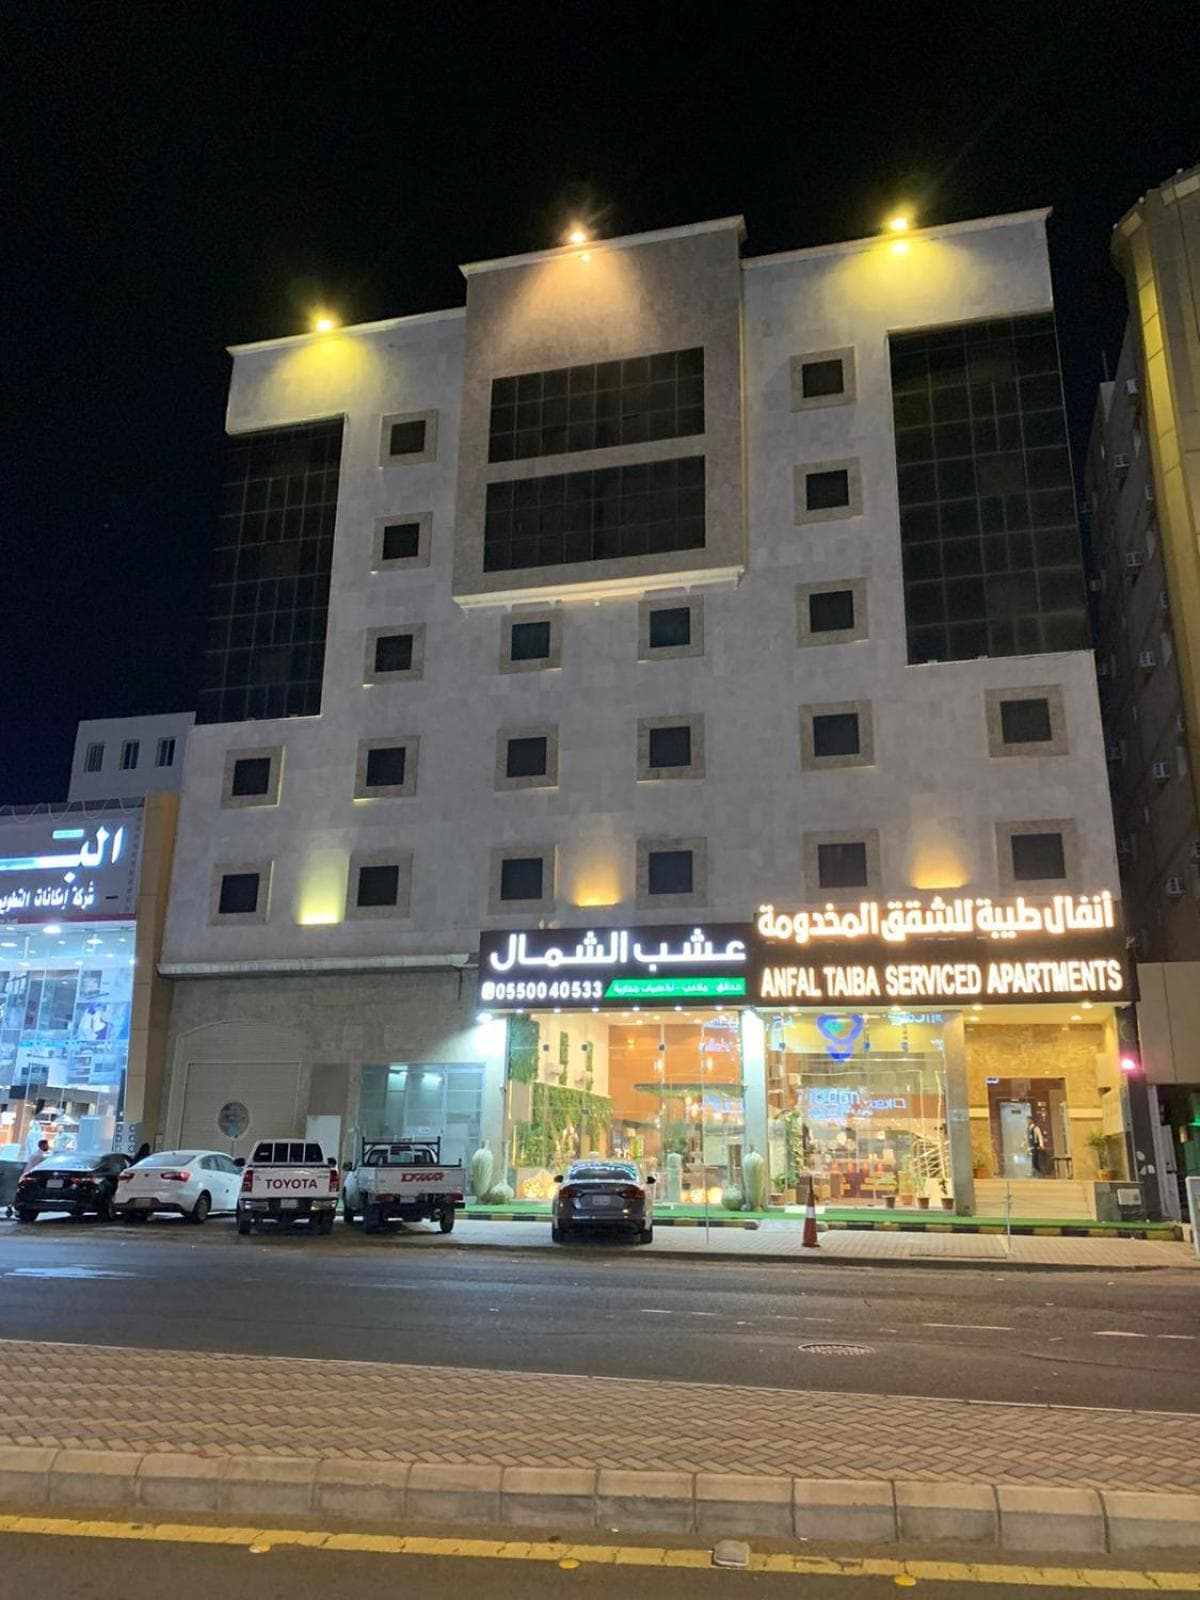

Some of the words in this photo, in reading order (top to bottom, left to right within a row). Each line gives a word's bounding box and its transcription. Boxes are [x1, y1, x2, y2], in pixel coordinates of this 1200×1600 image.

[72, 881, 95, 910] شركة
[758, 901, 880, 944] المخدومة
[880, 896, 974, 943] للشقق
[976, 897, 1043, 939] طيبة
[489, 930, 629, 971] الشمال
[633, 928, 746, 972] عشب
[760, 965, 822, 997] ANFAL
[823, 965, 881, 996] TAIBA
[885, 963, 982, 996] SERVICED
[987, 959, 1123, 993] APARTMENTS
[264, 1178, 318, 1190] TOYOTA
